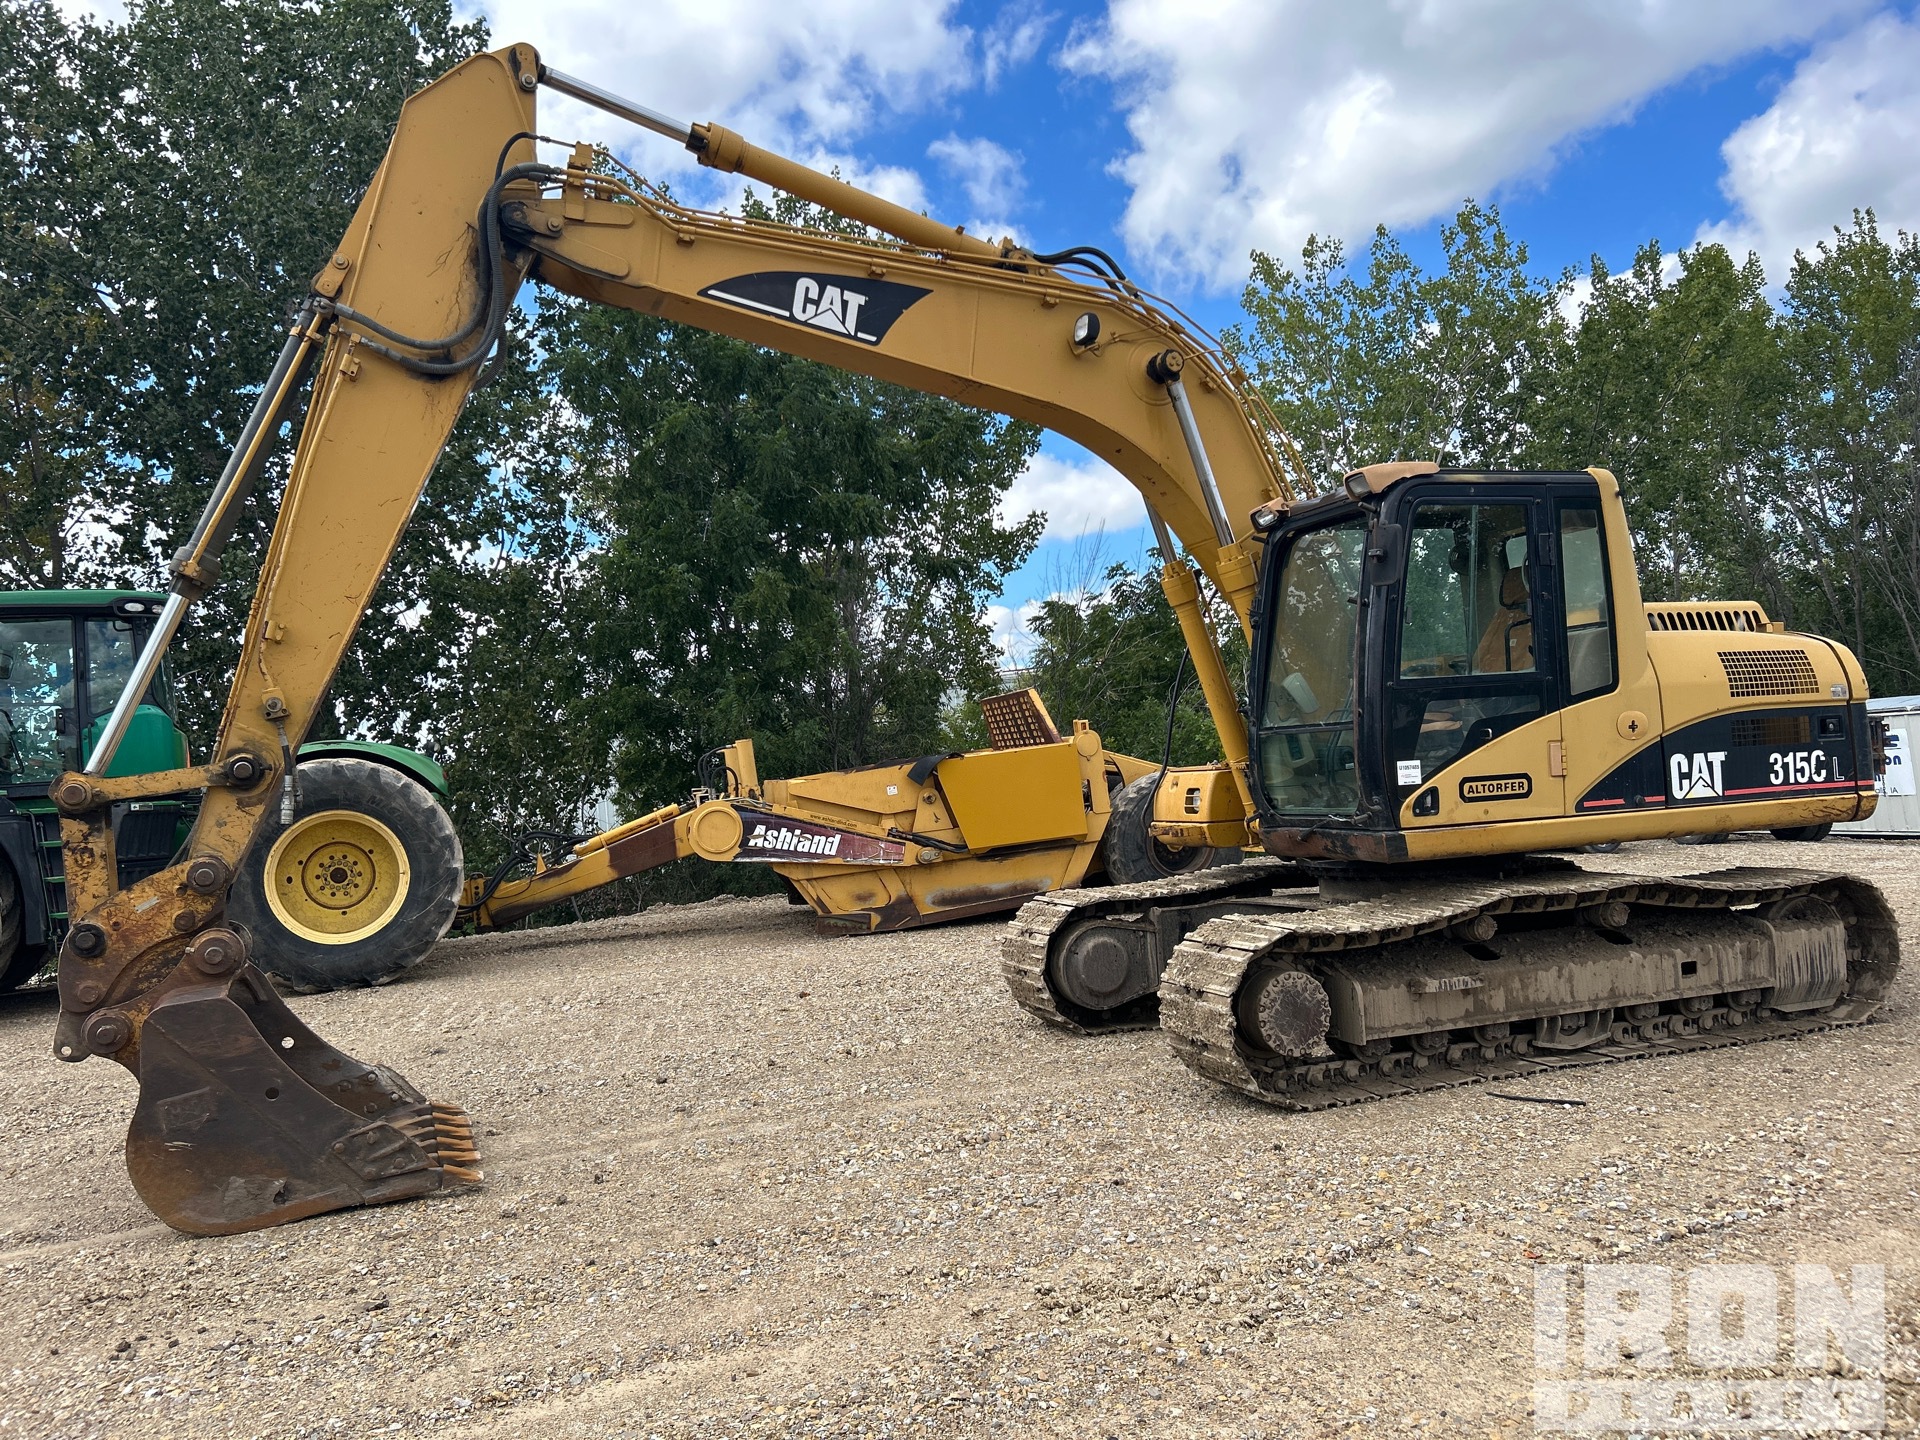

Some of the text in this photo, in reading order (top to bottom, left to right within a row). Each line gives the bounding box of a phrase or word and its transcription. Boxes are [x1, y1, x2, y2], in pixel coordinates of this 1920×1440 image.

[792, 277, 867, 336] CAT
[1467, 781, 1525, 795] ALTORFER
[1670, 750, 1845, 799] CAT 315C L
[747, 824, 842, 856] Ashland
